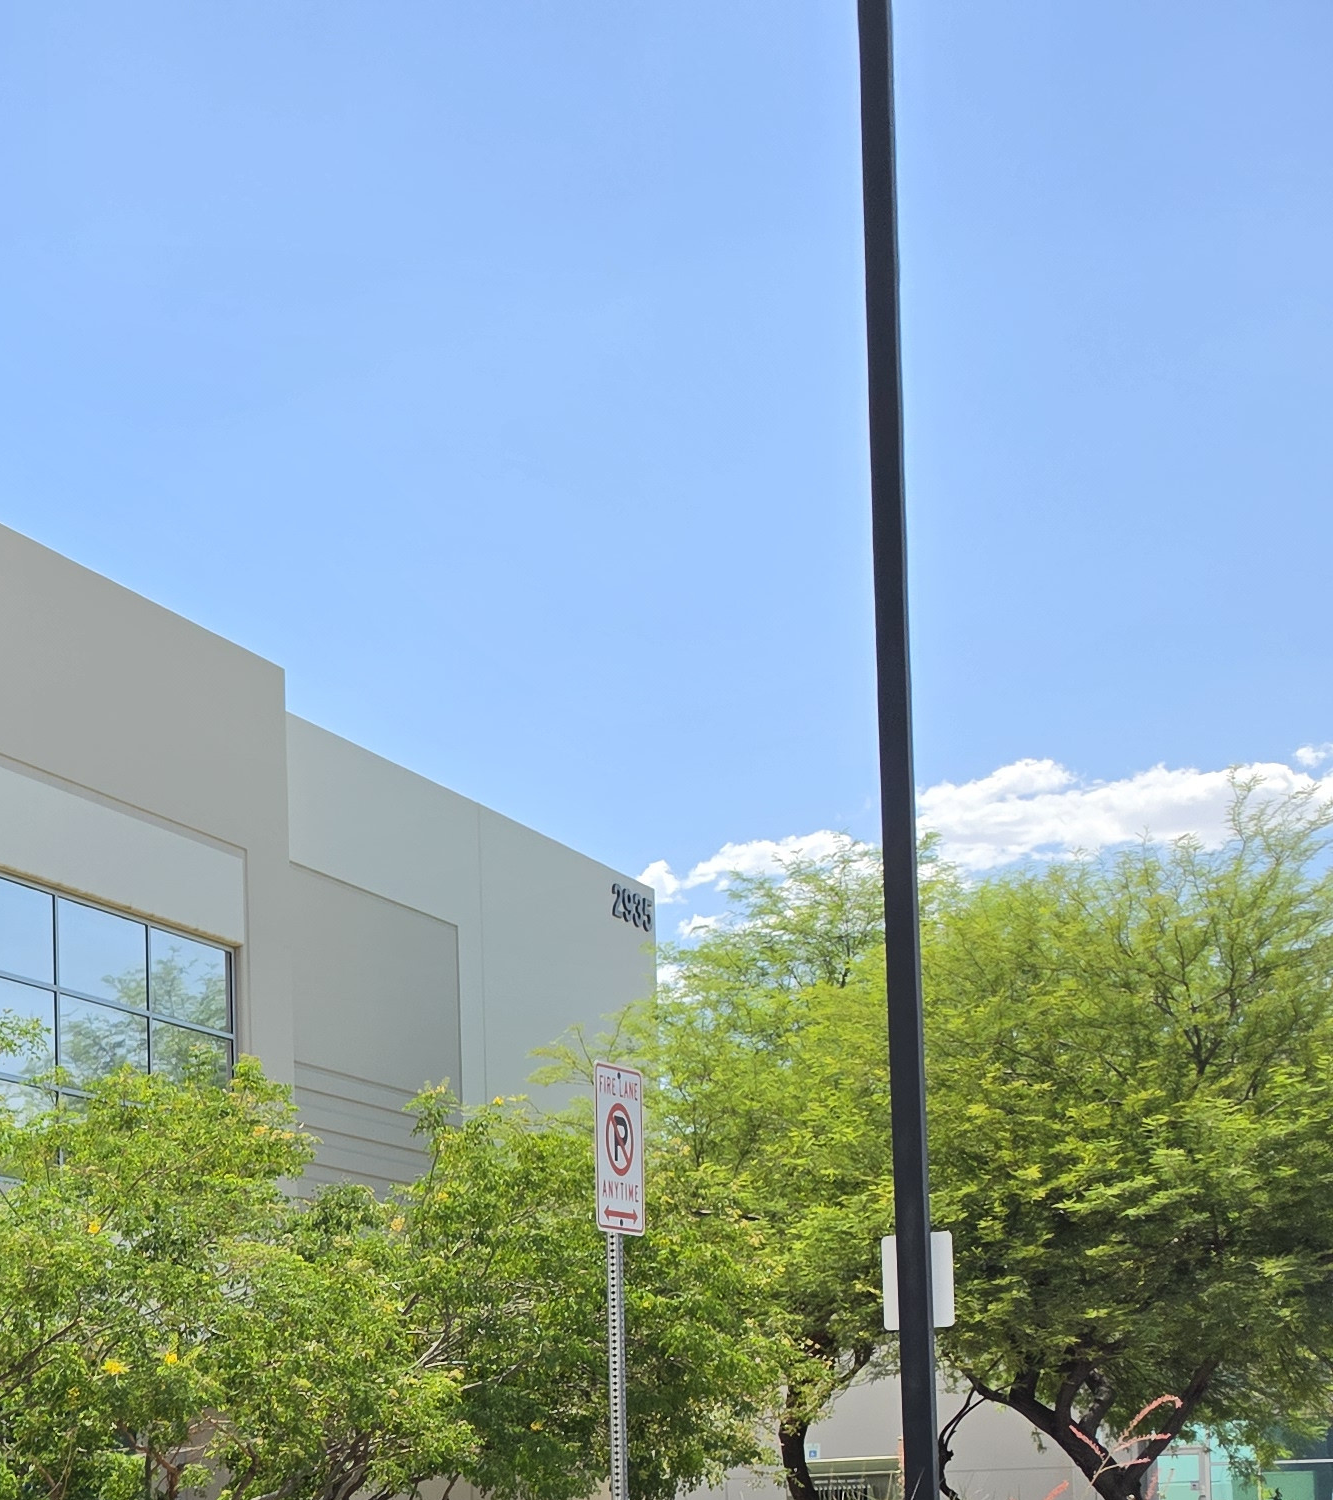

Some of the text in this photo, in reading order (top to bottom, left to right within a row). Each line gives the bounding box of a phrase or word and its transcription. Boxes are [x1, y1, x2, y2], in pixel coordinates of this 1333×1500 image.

[611, 883, 653, 932] 2935
[599, 1074, 638, 1101] FIRE LANE
[602, 1179, 639, 1203] ANYTIME
